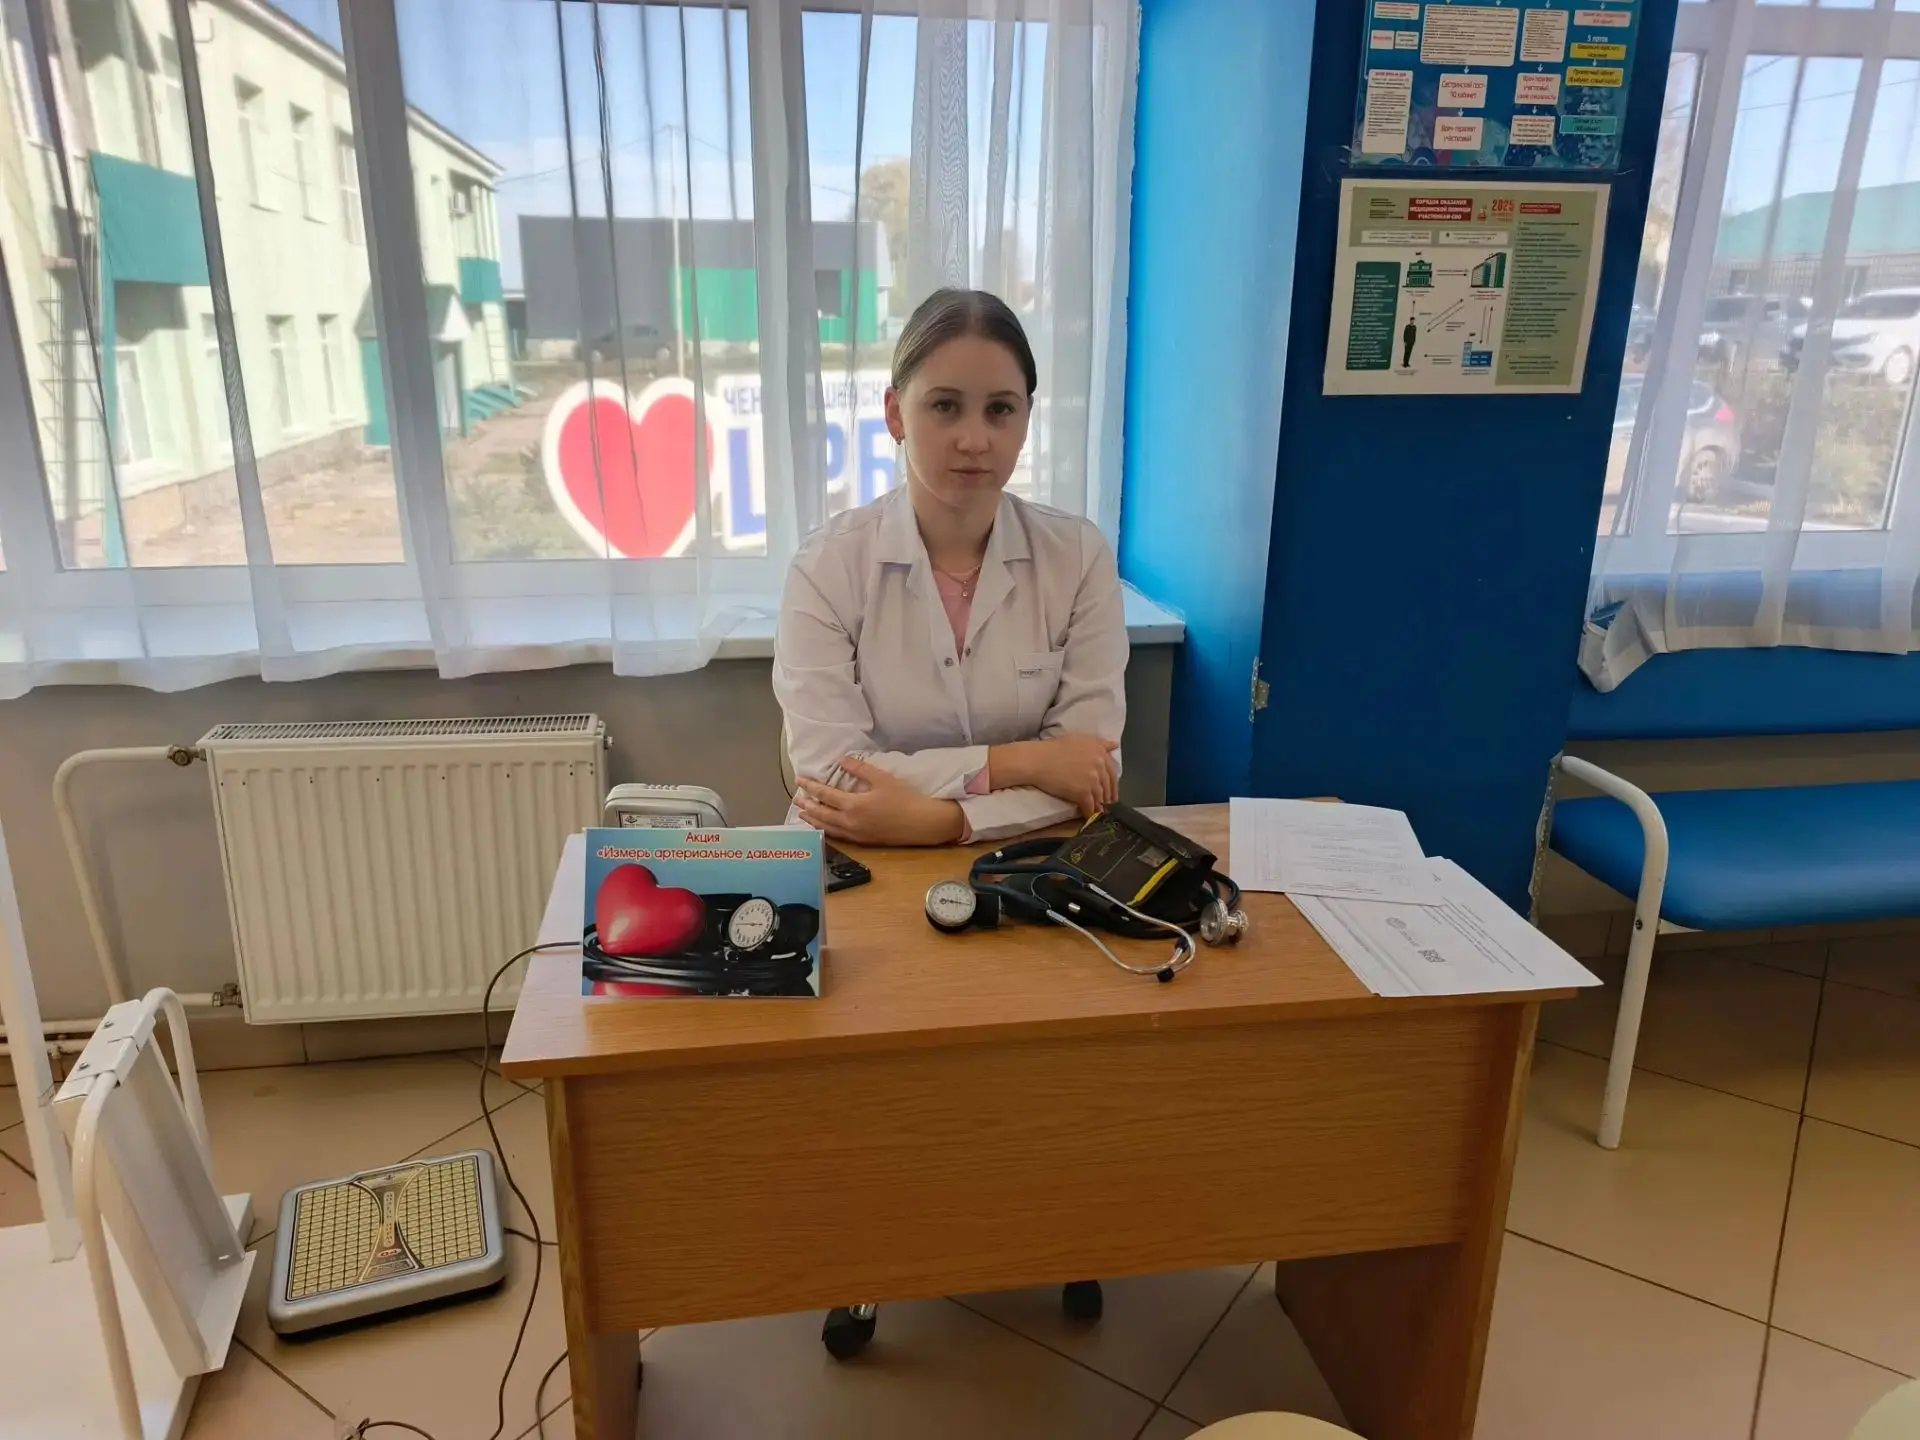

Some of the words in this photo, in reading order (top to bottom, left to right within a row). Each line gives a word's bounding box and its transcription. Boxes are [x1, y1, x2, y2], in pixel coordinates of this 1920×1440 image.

[1492, 199, 1515, 212] 2025
[686, 832, 721, 843] Акция
[596, 846, 650, 859] «Измерь
[655, 848, 743, 859] артериальное
[747, 849, 812, 859] давление»
